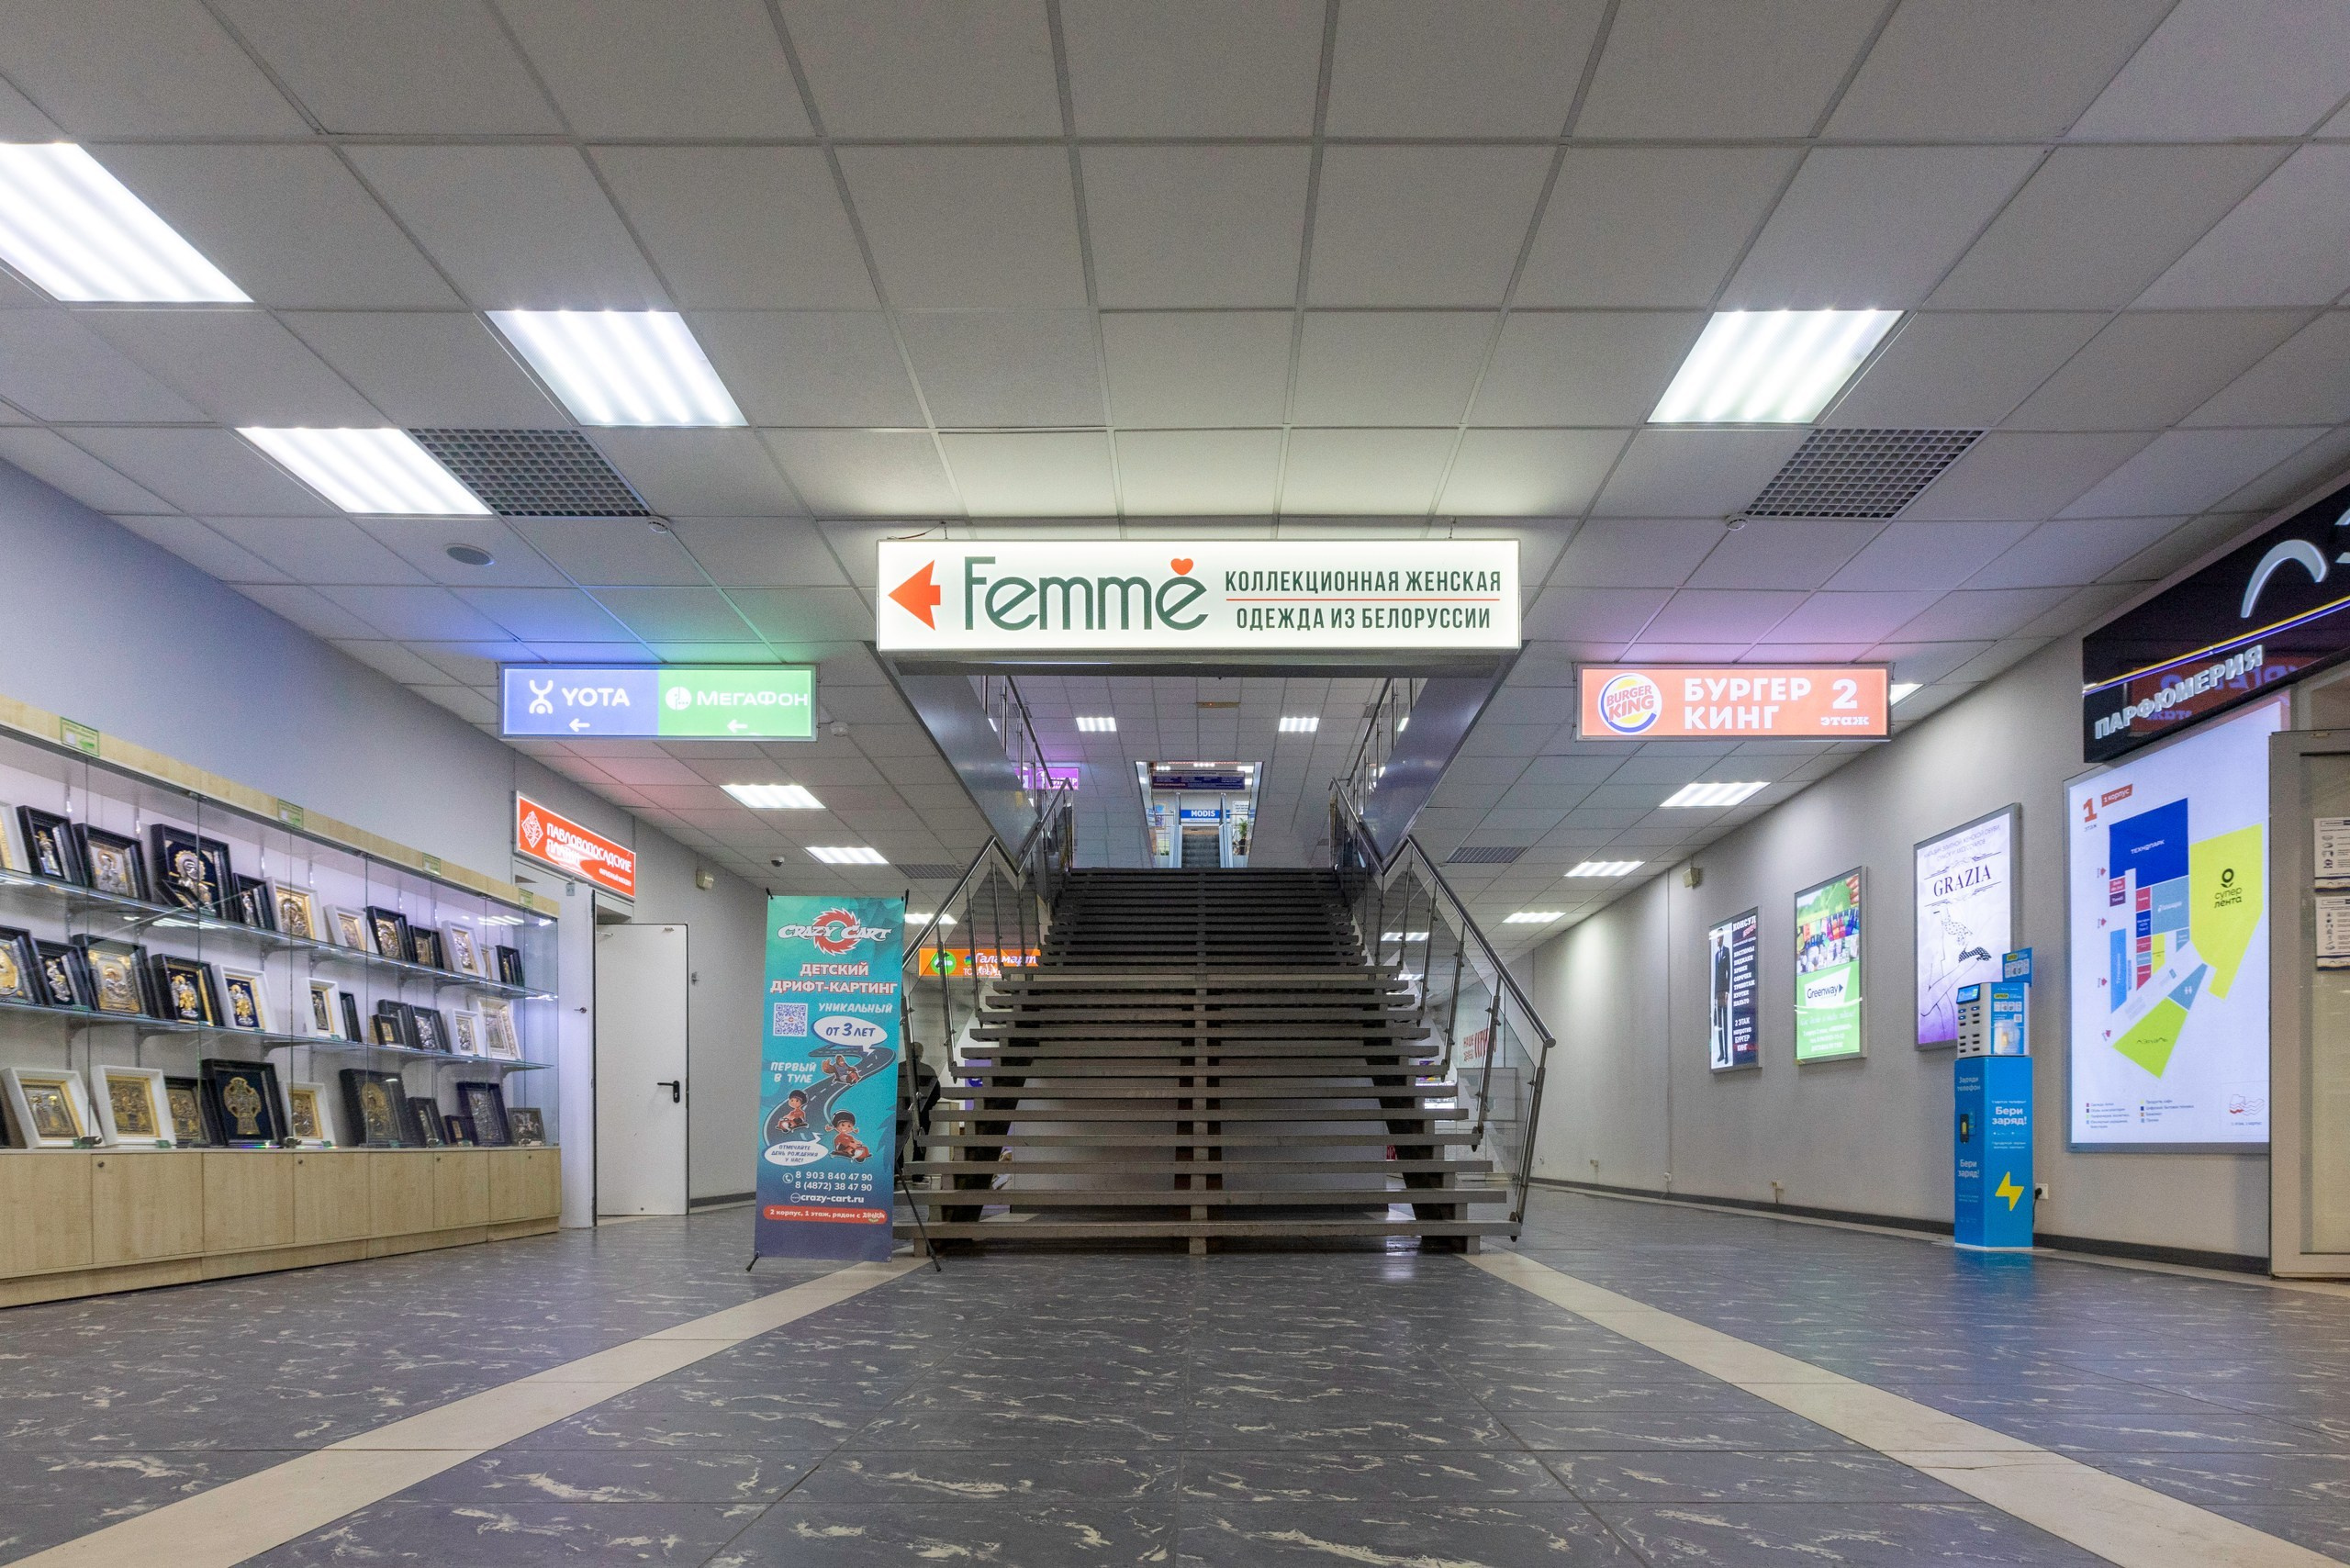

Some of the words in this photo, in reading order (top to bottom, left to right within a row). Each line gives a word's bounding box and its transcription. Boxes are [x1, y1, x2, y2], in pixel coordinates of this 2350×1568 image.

[1225, 570, 1400, 592] КОЛЛЕКЦИОННАЯ
[1404, 570, 1501, 592] ЖЕНСКАЯ
[964, 556, 1209, 632] Femme
[1237, 607, 1325, 632] ОДЕЖДА
[1331, 608, 1355, 629] ИЗ
[1361, 608, 1491, 629] БЕЛОРУССИИ
[1606, 685, 1652, 707] BURGER
[1684, 678, 1811, 702] БУРГЕР
[1831, 678, 1858, 710] 2
[2094, 644, 2265, 740] ПАРФЮМЕРИЯ
[562, 688, 631, 707] YOTA
[1608, 694, 1654, 722] KING
[1684, 706, 1779, 730] КИНГ
[1820, 715, 1869, 726] этаж
[2109, 788, 2130, 801] корпус
[2083, 798, 2097, 823] 1
[547, 823, 632, 873] ПАВЛОВОПОСАДСКИЕ
[1933, 864, 1991, 897] GRAZIA
[2214, 888, 2243, 900] супер
[2214, 896, 2242, 908] лента
[778, 924, 838, 939] CRAZY
[840, 924, 892, 942] CART
[800, 962, 868, 977] ДЕТСКИЙ
[770, 980, 898, 995] ДРИФТ-КАРТИНГ
[1807, 985, 1838, 999] Greenway
[819, 1002, 892, 1014] УНИКАЛЬНЫЙ
[826, 1027, 840, 1036] ОТ
[842, 1023, 852, 1036] 3
[853, 1027, 876, 1036] ЛЕТ
[770, 1061, 817, 1071] ПЕРВЫЙ
[774, 1073, 782, 1082] В
[788, 1074, 812, 1083] ТУЛЕ
[1995, 1106, 2023, 1116] Бери
[1992, 1116, 2028, 1126] заряд!
[1959, 1159, 1977, 1169] Бери
[828, 1172, 846, 1181] 840
[861, 1173, 873, 1182] 90
[1958, 1169, 1980, 1179] заряд!
[804, 1182, 832, 1191] (4872)
[834, 1182, 845, 1191] 38
[861, 1183, 872, 1192] 90
[800, 1194, 865, 1204] crazy-cart.ru
